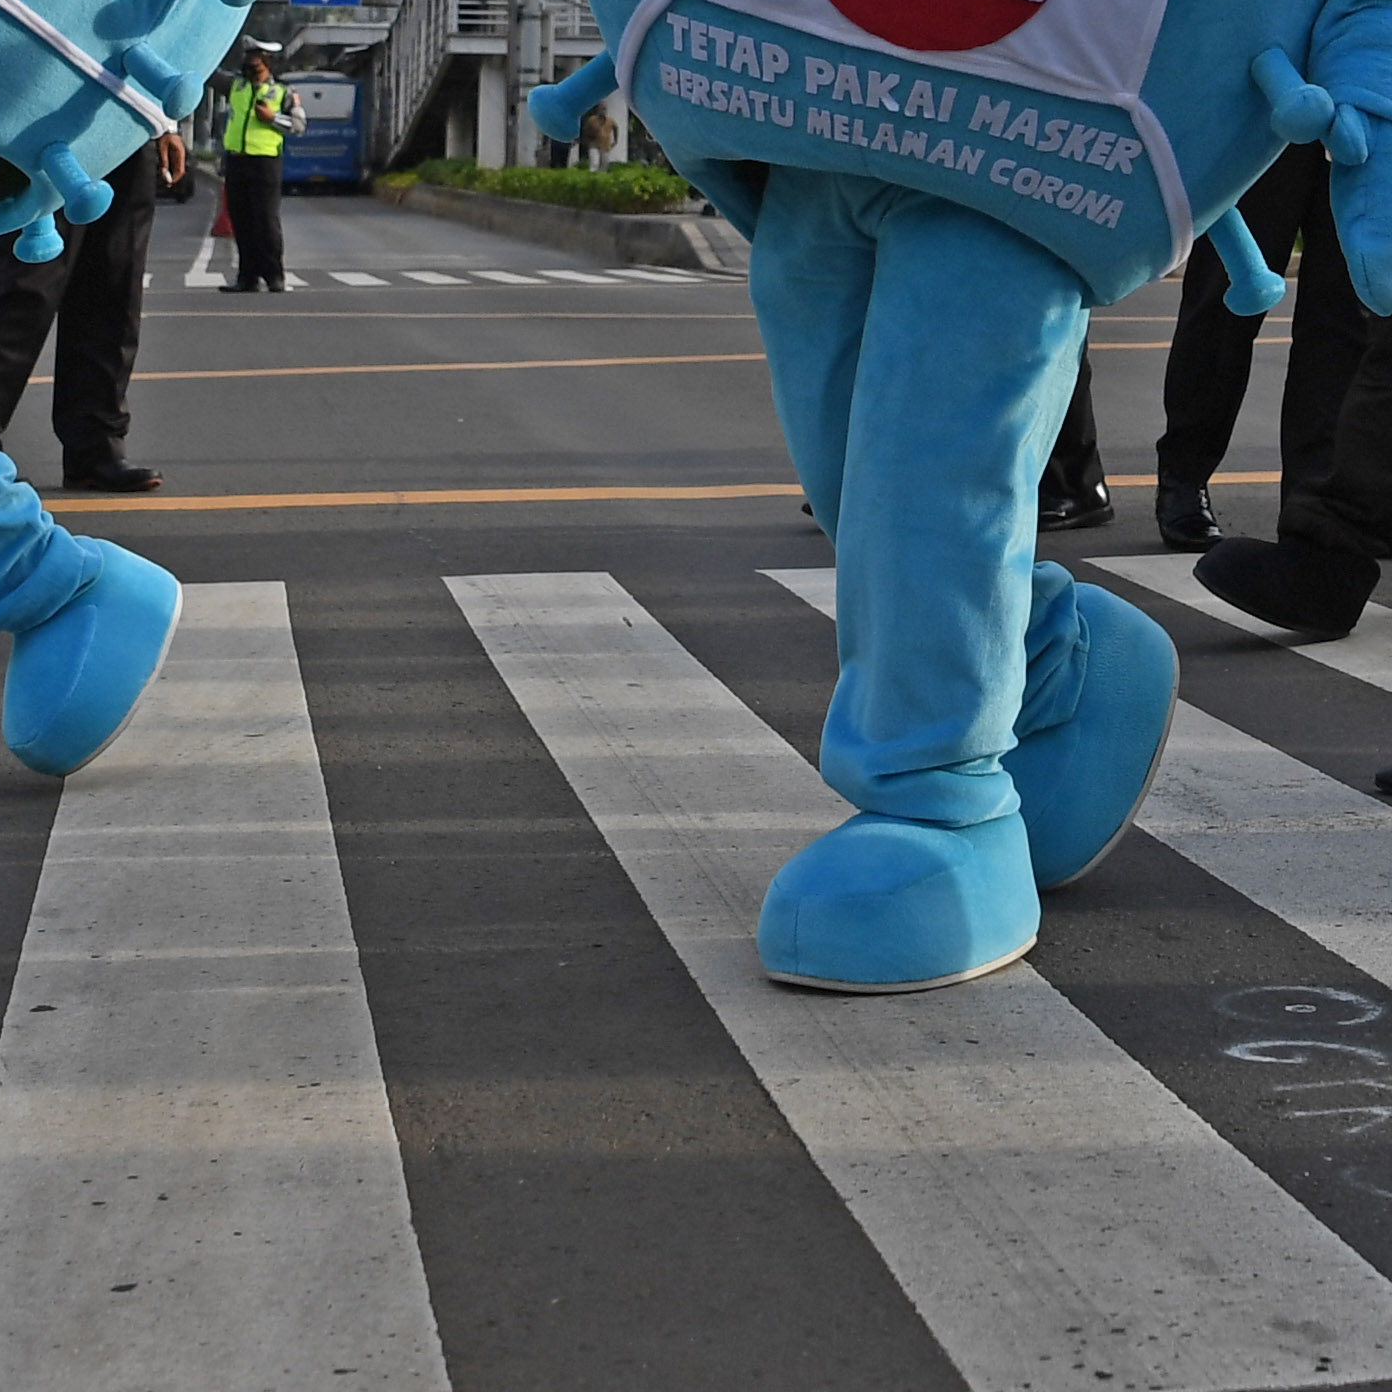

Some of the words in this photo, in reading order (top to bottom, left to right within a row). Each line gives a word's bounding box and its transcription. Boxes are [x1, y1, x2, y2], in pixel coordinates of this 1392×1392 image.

[659, 61, 795, 128] BERSATU
[807, 107, 985, 175] MELAWAN
[989, 157, 1125, 229] CORONA
[666, 10, 789, 85] TETAP
[805, 56, 957, 122] PAKAI
[971, 94, 1144, 176] MASKER
